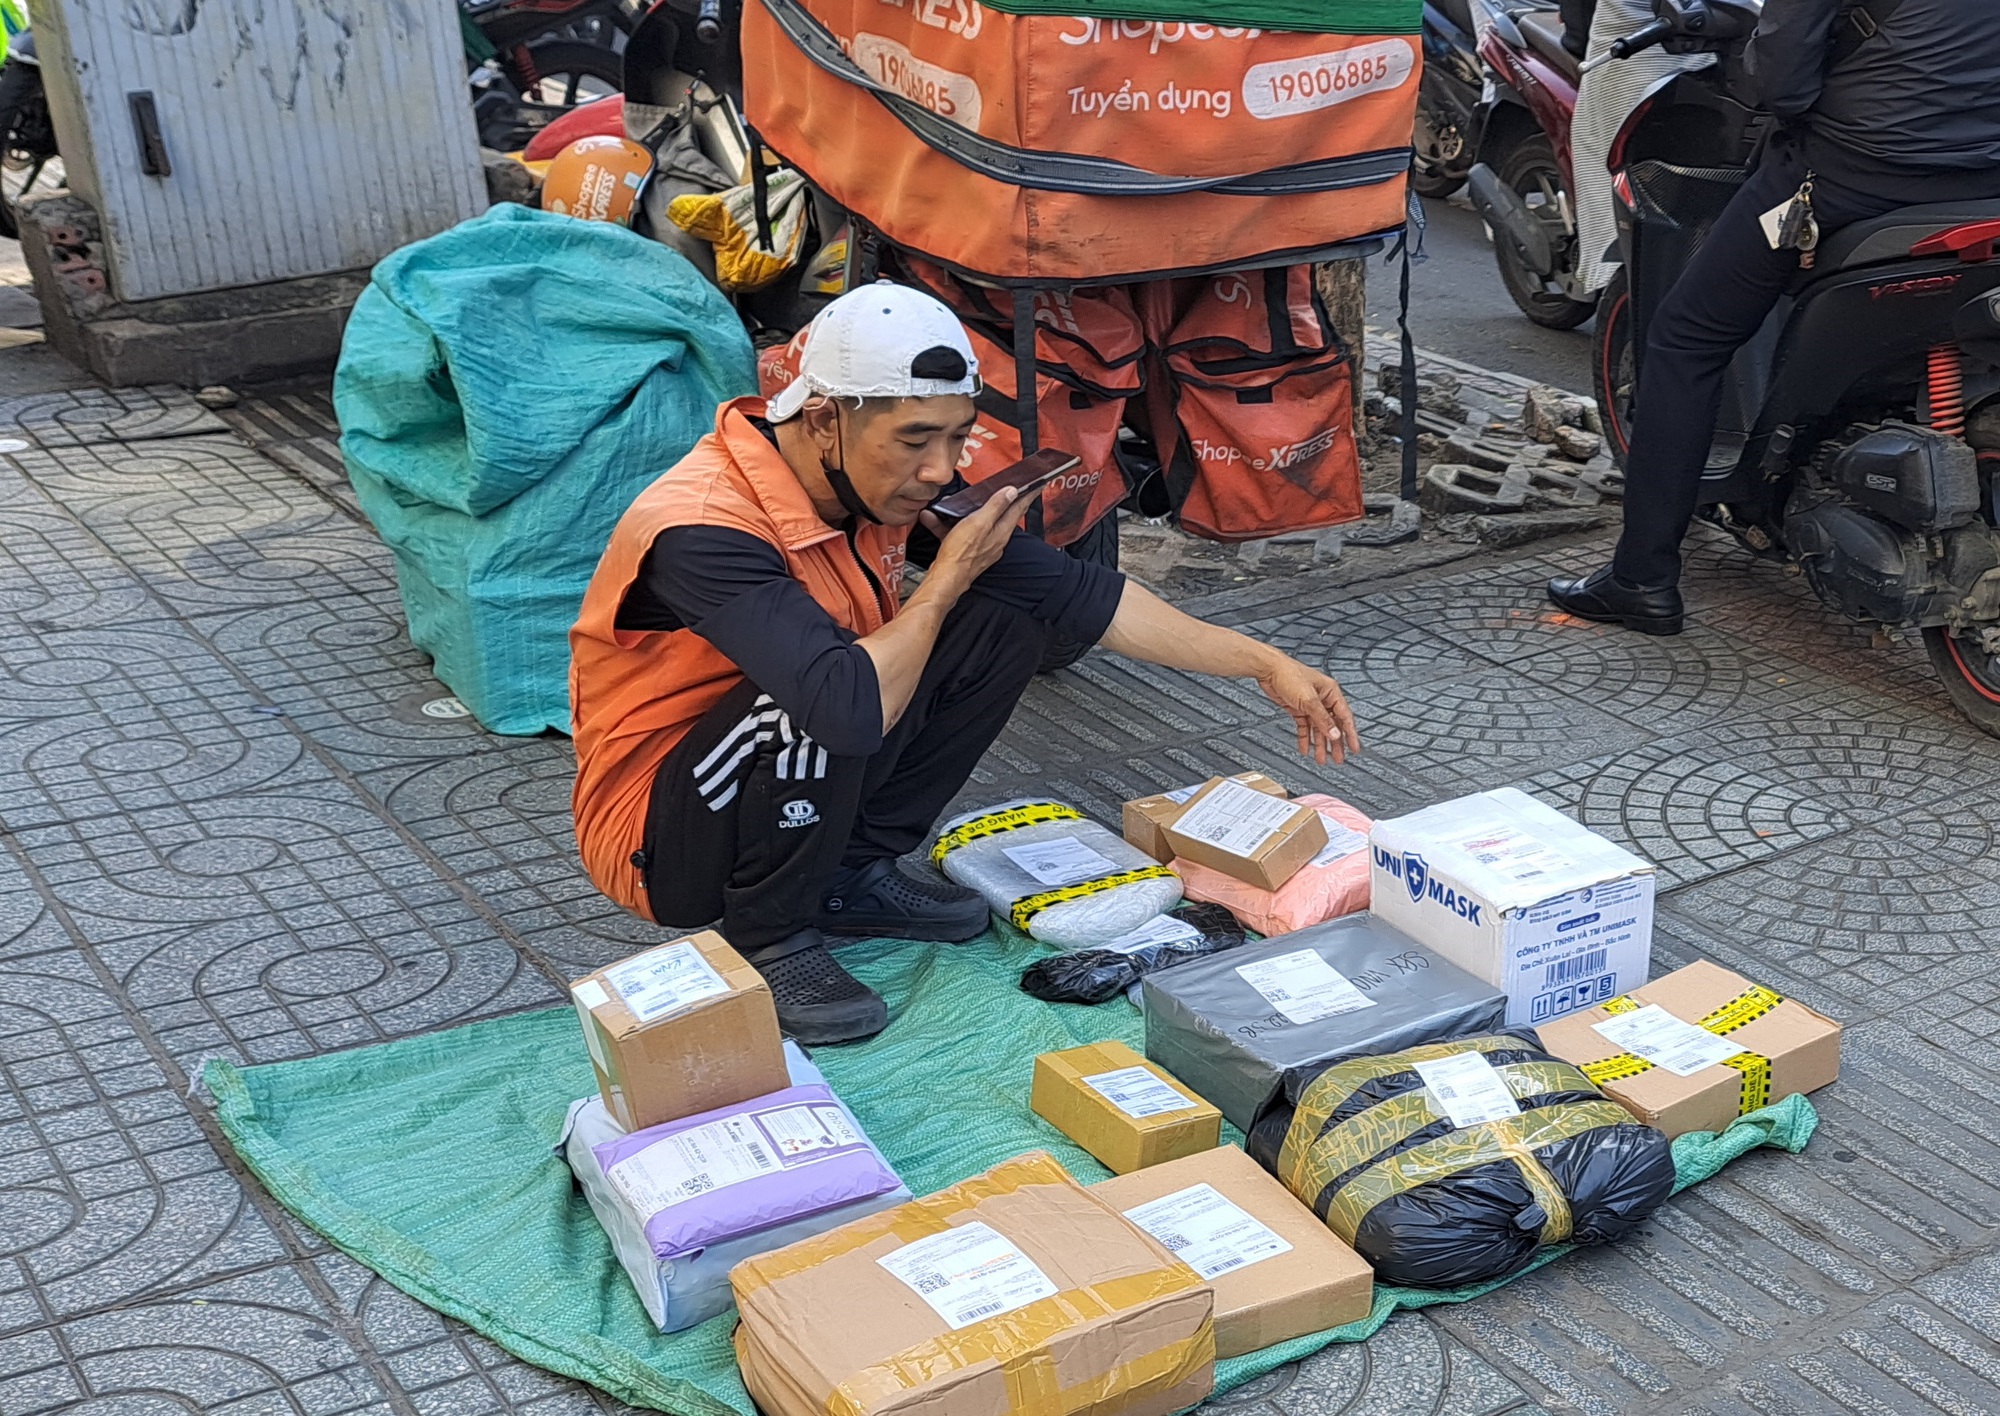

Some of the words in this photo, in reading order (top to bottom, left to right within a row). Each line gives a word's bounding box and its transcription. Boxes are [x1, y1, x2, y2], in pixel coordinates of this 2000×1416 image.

[1068, 79, 1149, 118] Tuyển
[1158, 81, 1231, 118] dụng
[1268, 55, 1388, 103] 19006885
[1373, 844, 1401, 879] UNI
[1427, 876, 1482, 927] MASK
[1516, 944, 1540, 958] CÔNG
[1542, 940, 1553, 951] TY
[1554, 934, 1576, 947] TNHH
[1577, 929, 1588, 940] VÀ
